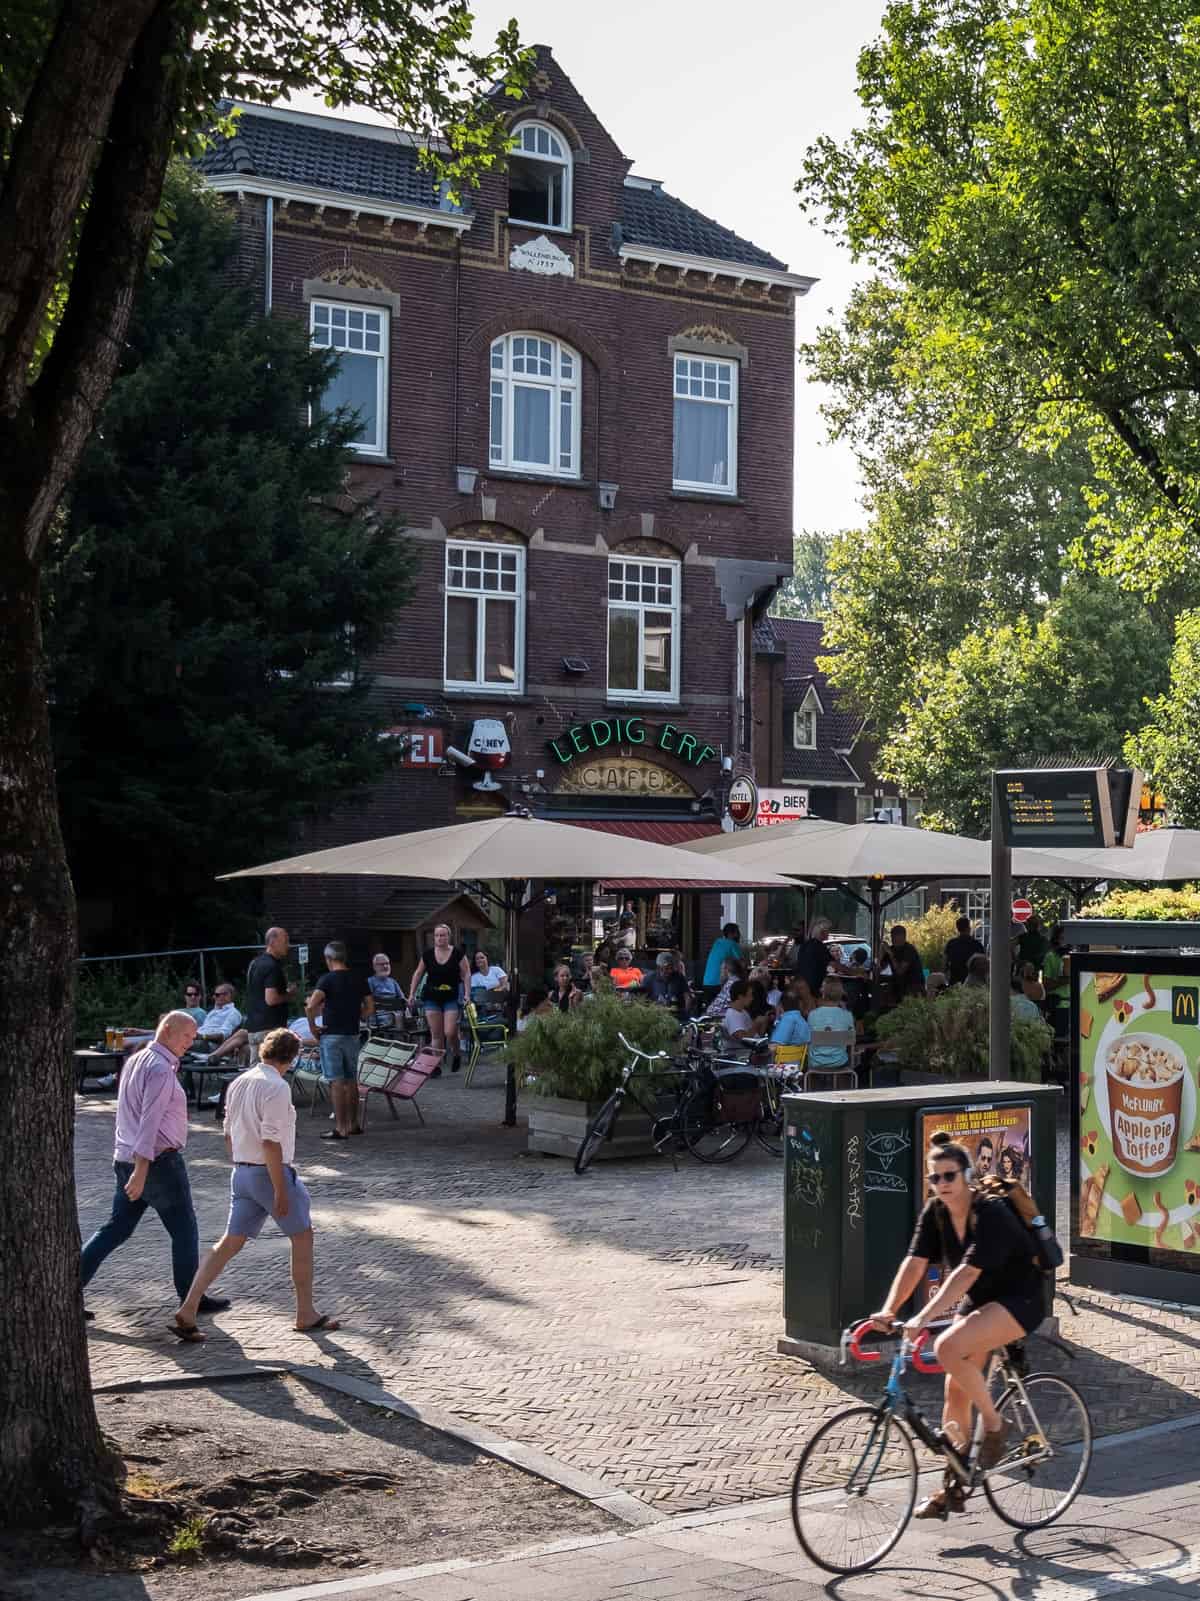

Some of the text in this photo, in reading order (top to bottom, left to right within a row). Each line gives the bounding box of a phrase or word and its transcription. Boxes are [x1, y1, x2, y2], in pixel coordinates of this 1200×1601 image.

[552, 717, 716, 766] LEDIG ERF
[783, 795, 806, 809] BIER
[757, 816, 769, 826] DE
[1117, 1116, 1151, 1140] Apple
[1126, 1139, 1165, 1160] Toffee
